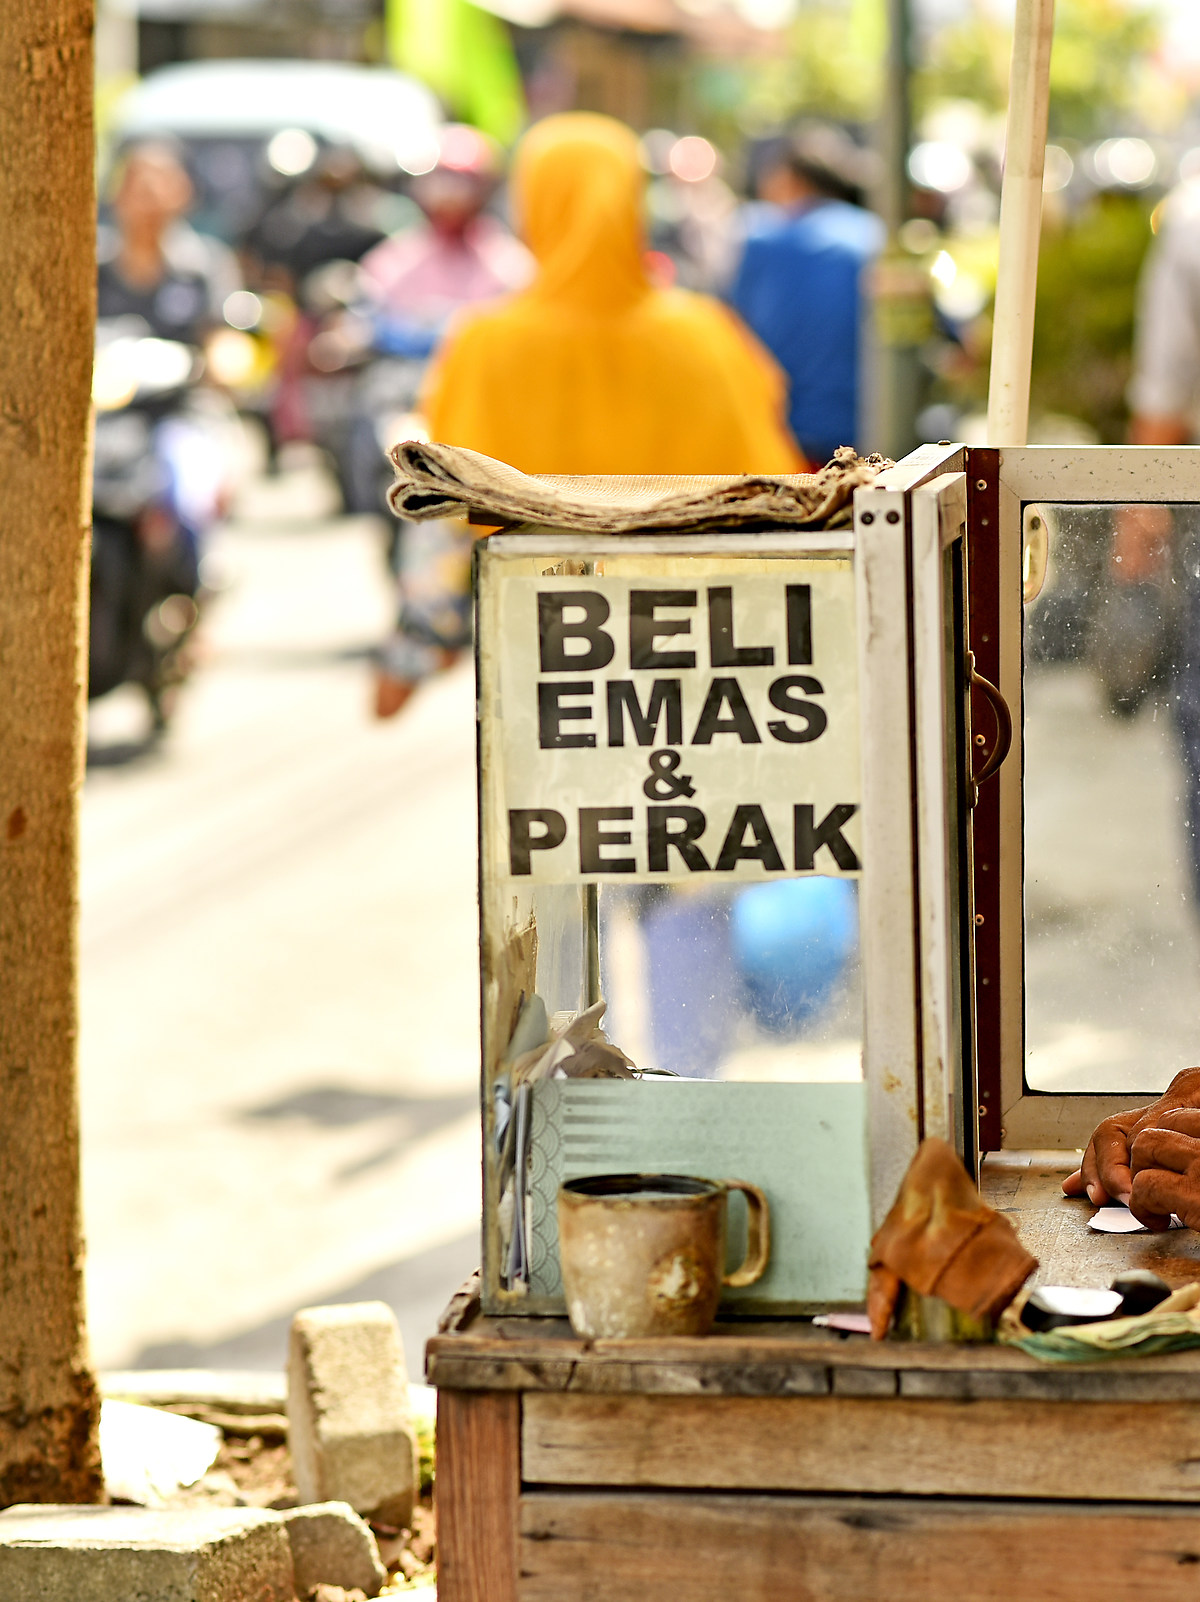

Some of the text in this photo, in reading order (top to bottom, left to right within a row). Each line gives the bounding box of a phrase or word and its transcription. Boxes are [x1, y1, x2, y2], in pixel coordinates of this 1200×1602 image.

[537, 584, 814, 672] BELI
[538, 675, 828, 749] EMAS
[643, 749, 696, 801] &
[508, 804, 863, 875] PERAK
